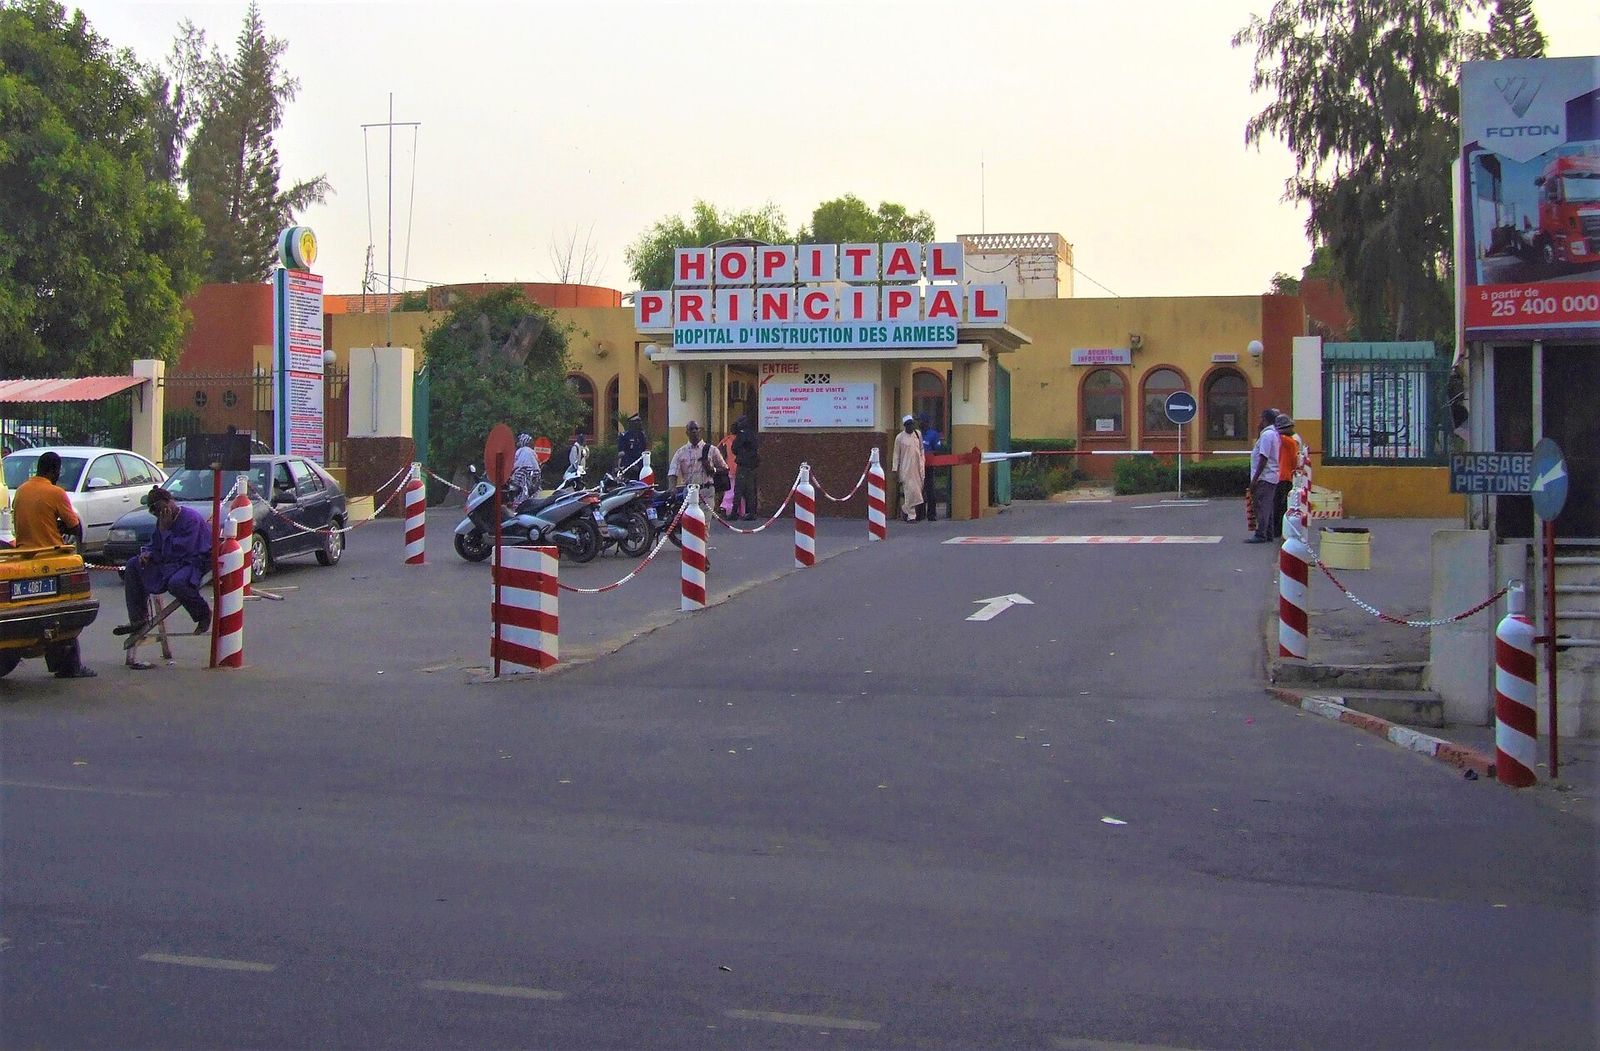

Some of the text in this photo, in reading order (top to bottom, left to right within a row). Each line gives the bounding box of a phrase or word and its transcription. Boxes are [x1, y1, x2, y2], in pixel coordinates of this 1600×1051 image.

[1486, 124, 1560, 138] FOTON
[680, 247, 957, 281] HOPITAL
[1490, 288, 1522, 301] partir
[1524, 288, 1539, 298] de
[640, 289, 999, 324] PRINCIPAL
[1491, 294, 1600, 317] 25 400 000
[674, 324, 956, 345] HOPITAL D'INSTRUCTION DES ARMEES
[762, 363, 800, 374] ENTREE
[1454, 455, 1533, 473] PASSAGE
[1455, 474, 1531, 492] PIETONS
